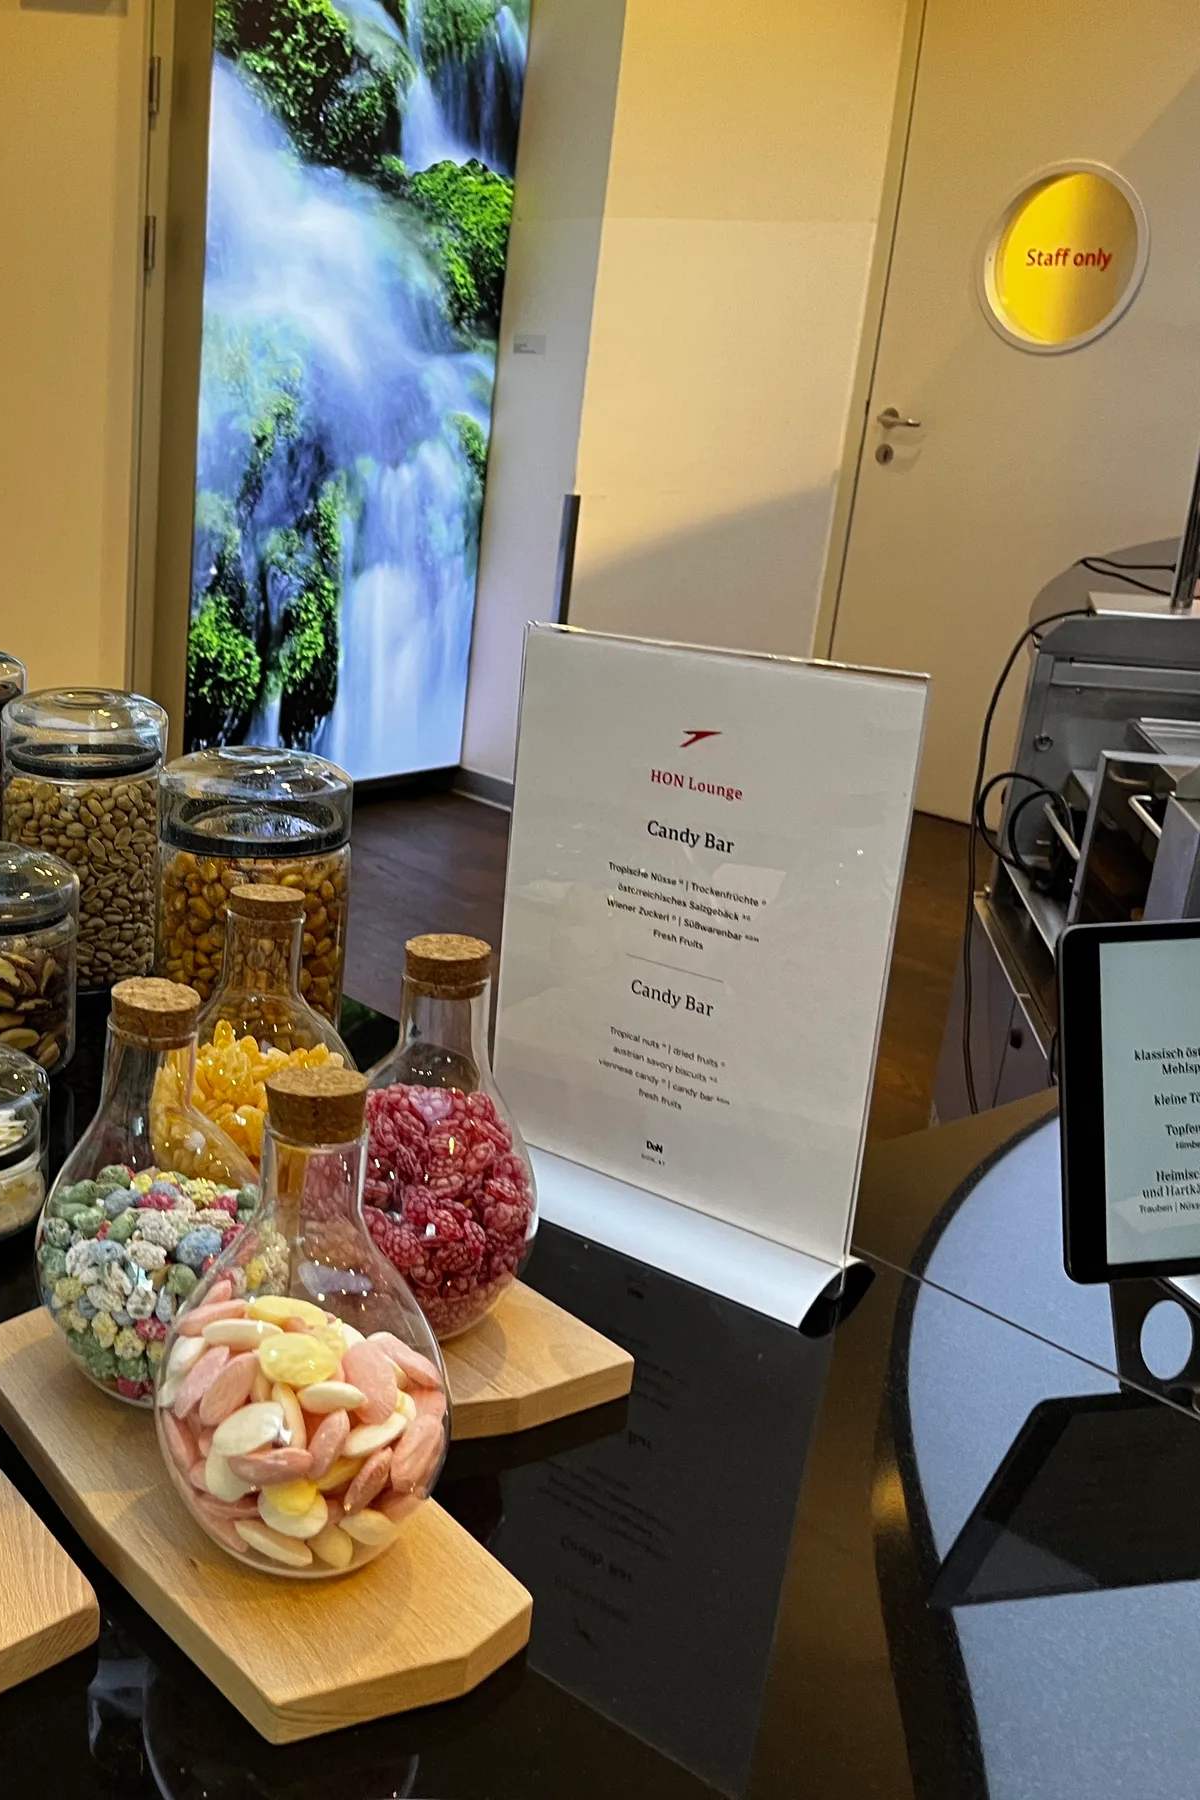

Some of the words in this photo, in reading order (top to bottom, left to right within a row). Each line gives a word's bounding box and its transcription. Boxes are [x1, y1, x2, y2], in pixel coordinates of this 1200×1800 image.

[1026, 247, 1071, 267] Staff
[1073, 247, 1113, 272] only
[650, 768, 685, 789] HON
[688, 776, 743, 801] Lounge
[647, 819, 700, 849] Candy
[704, 831, 735, 854] Bar
[608, 861, 649, 879] Tropische
[650, 871, 677, 886] Nüsse
[691, 881, 759, 907] Trockenfrüchte
[617, 882, 687, 908] österreichisches
[689, 900, 739, 921] Salzgebäck
[606, 897, 636, 913] Wiener
[638, 906, 670, 922] Zuckerl
[683, 918, 742, 942] Süßwarenbar
[653, 928, 677, 943] Fresh
[679, 935, 704, 950] Fruits
[631, 979, 681, 1009] Candy
[685, 994, 714, 1017] Bar
[610, 1025, 640, 1043] Tropical
[641, 1037, 660, 1049] nuts
[673, 1046, 695, 1061] dried
[697, 1054, 718, 1068] fruits
[1133, 1047, 1184, 1061] klassisch
[612, 1045, 645, 1062] austrian
[646, 1056, 673, 1073] savory
[675, 1065, 707, 1082] biscuits
[635, 1070, 659, 1086] candy
[672, 1083, 698, 1098] candy
[699, 1091, 714, 1102] bar
[638, 1087, 659, 1102] fresh
[661, 1096, 682, 1110] fruits
[1154, 1093, 1187, 1106] kleine
[1142, 1185, 1163, 1198] und
[1139, 1204, 1173, 1214] Trauben
